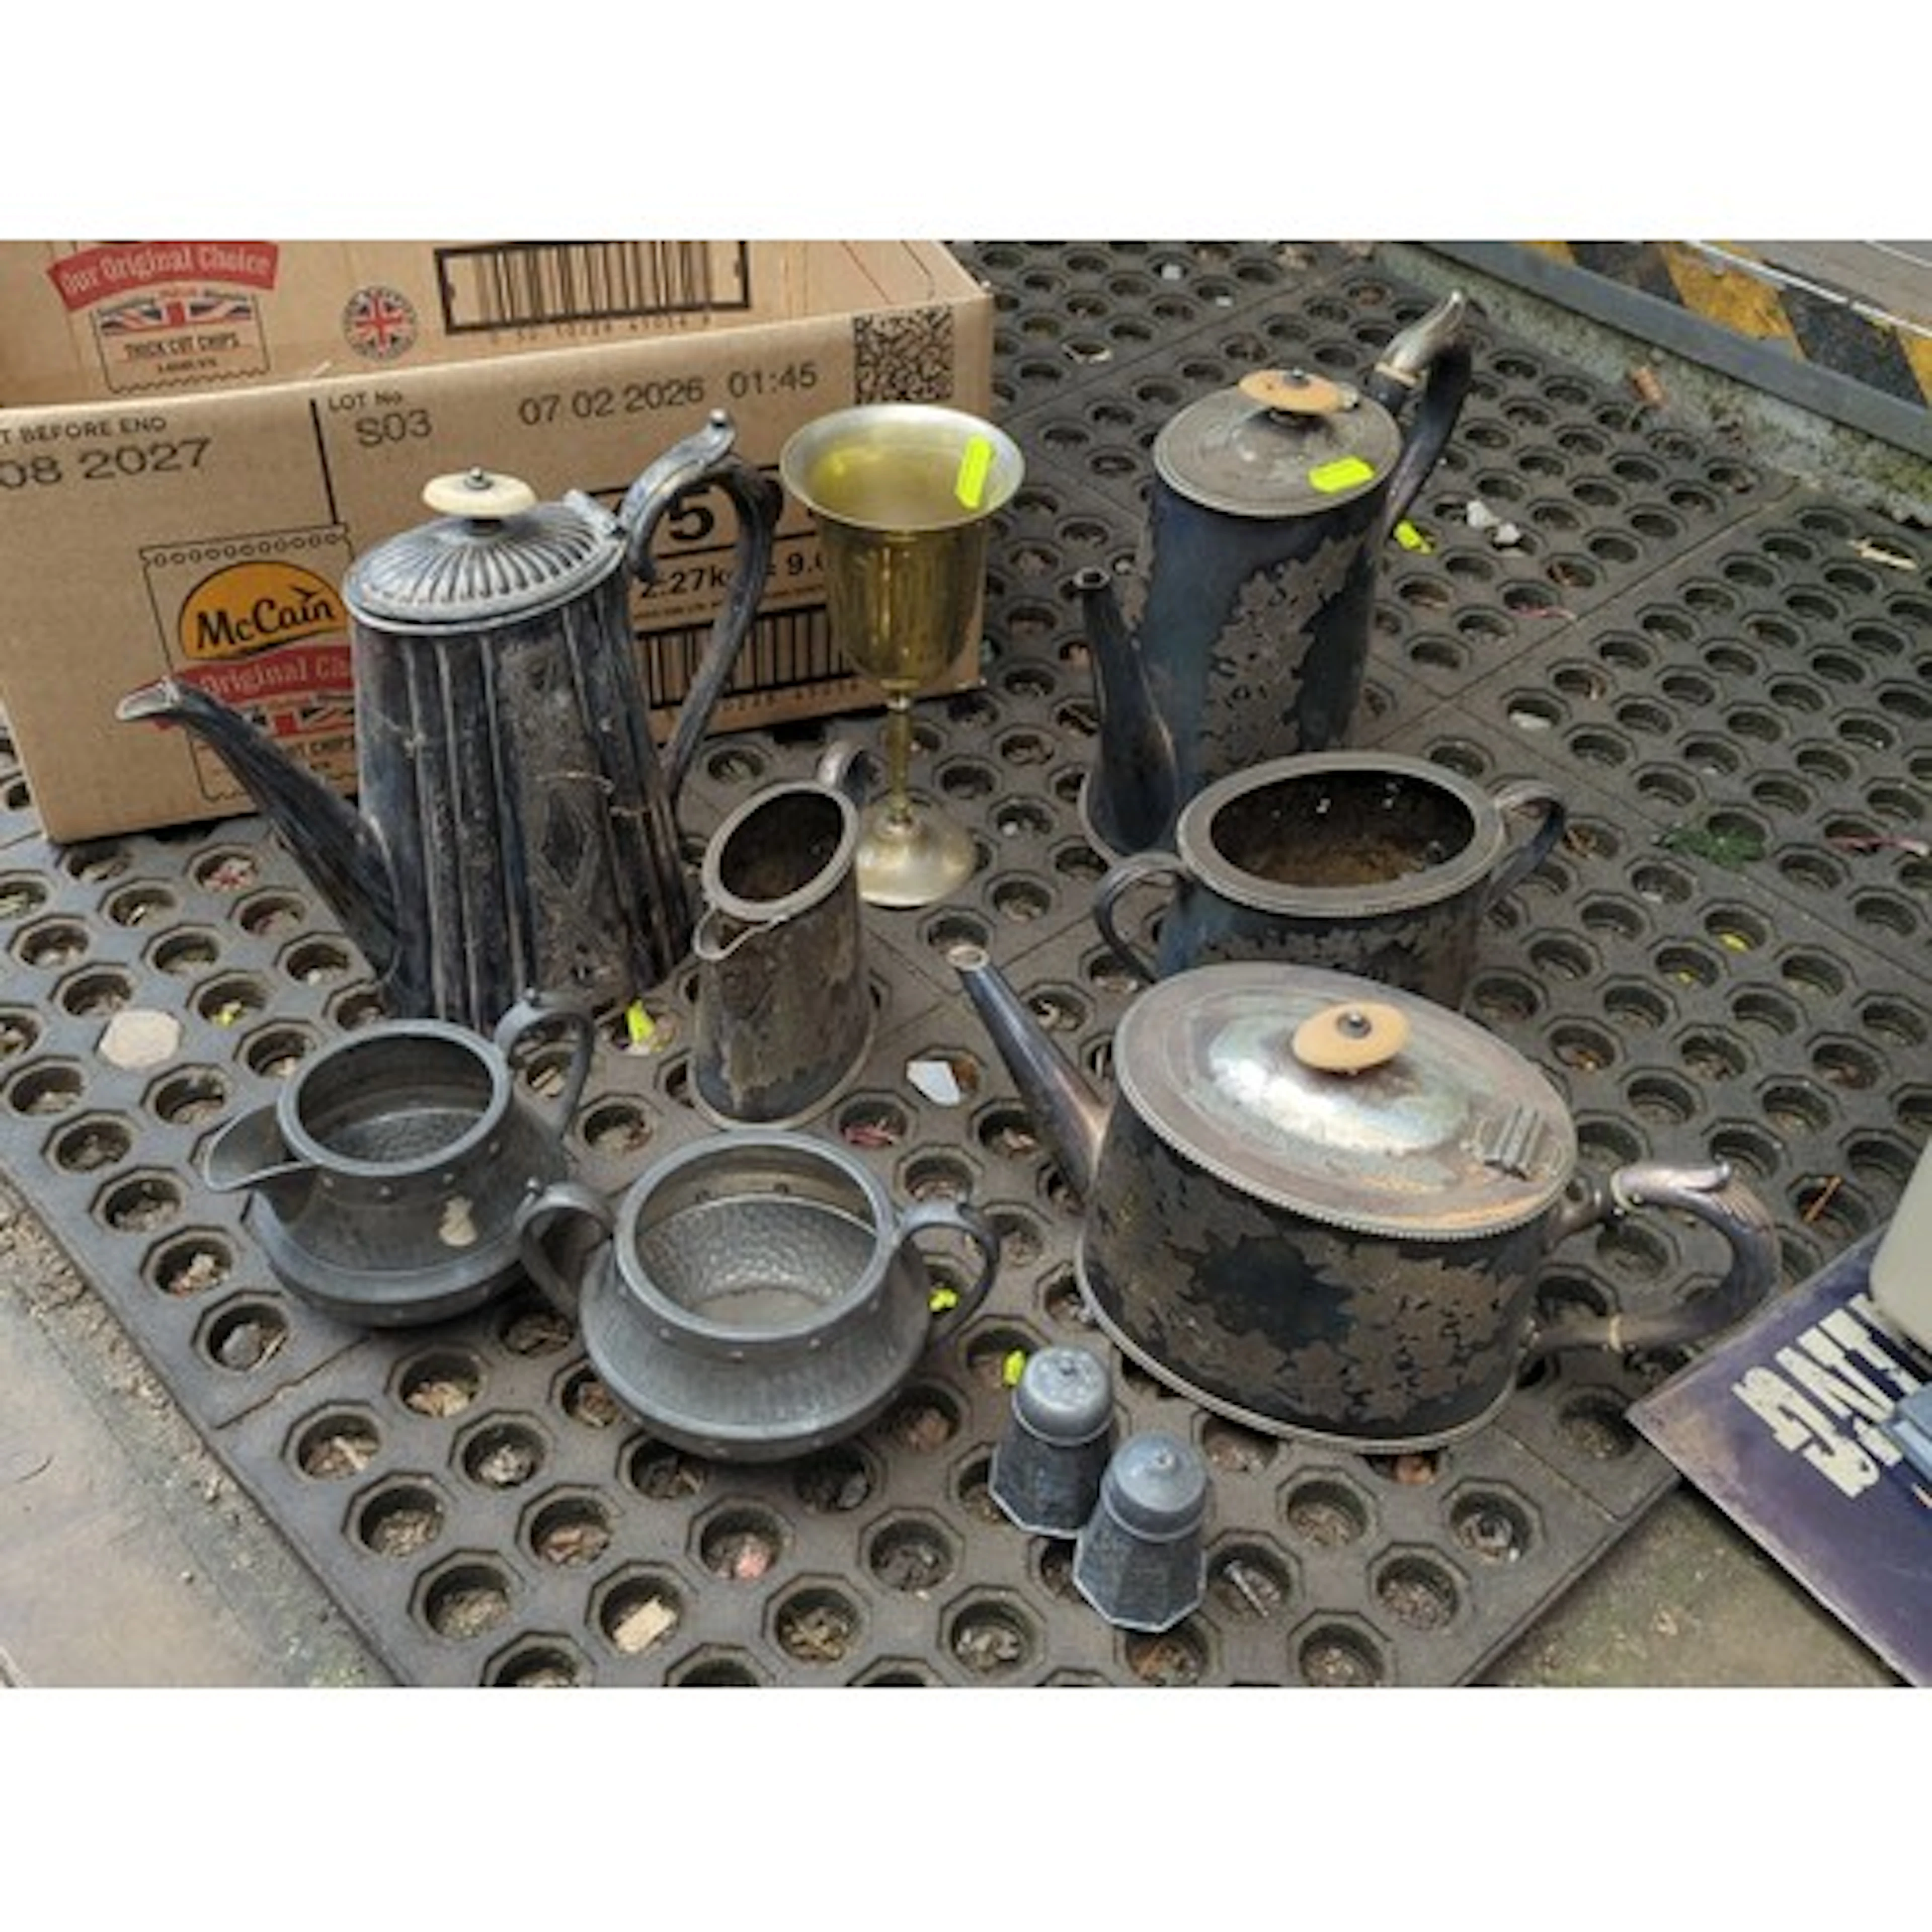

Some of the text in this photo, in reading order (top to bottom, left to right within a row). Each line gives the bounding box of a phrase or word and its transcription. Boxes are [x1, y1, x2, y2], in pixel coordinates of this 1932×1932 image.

[328, 391, 367, 413] LOT
[519, 362, 818, 425] 07 02 2026 01:45
[19, 418, 113, 444] BEFORE
[120, 416, 167, 434] END
[355, 408, 432, 448] S03
[0, 438, 212, 489] 08 2027
[197, 597, 333, 649] McCain
